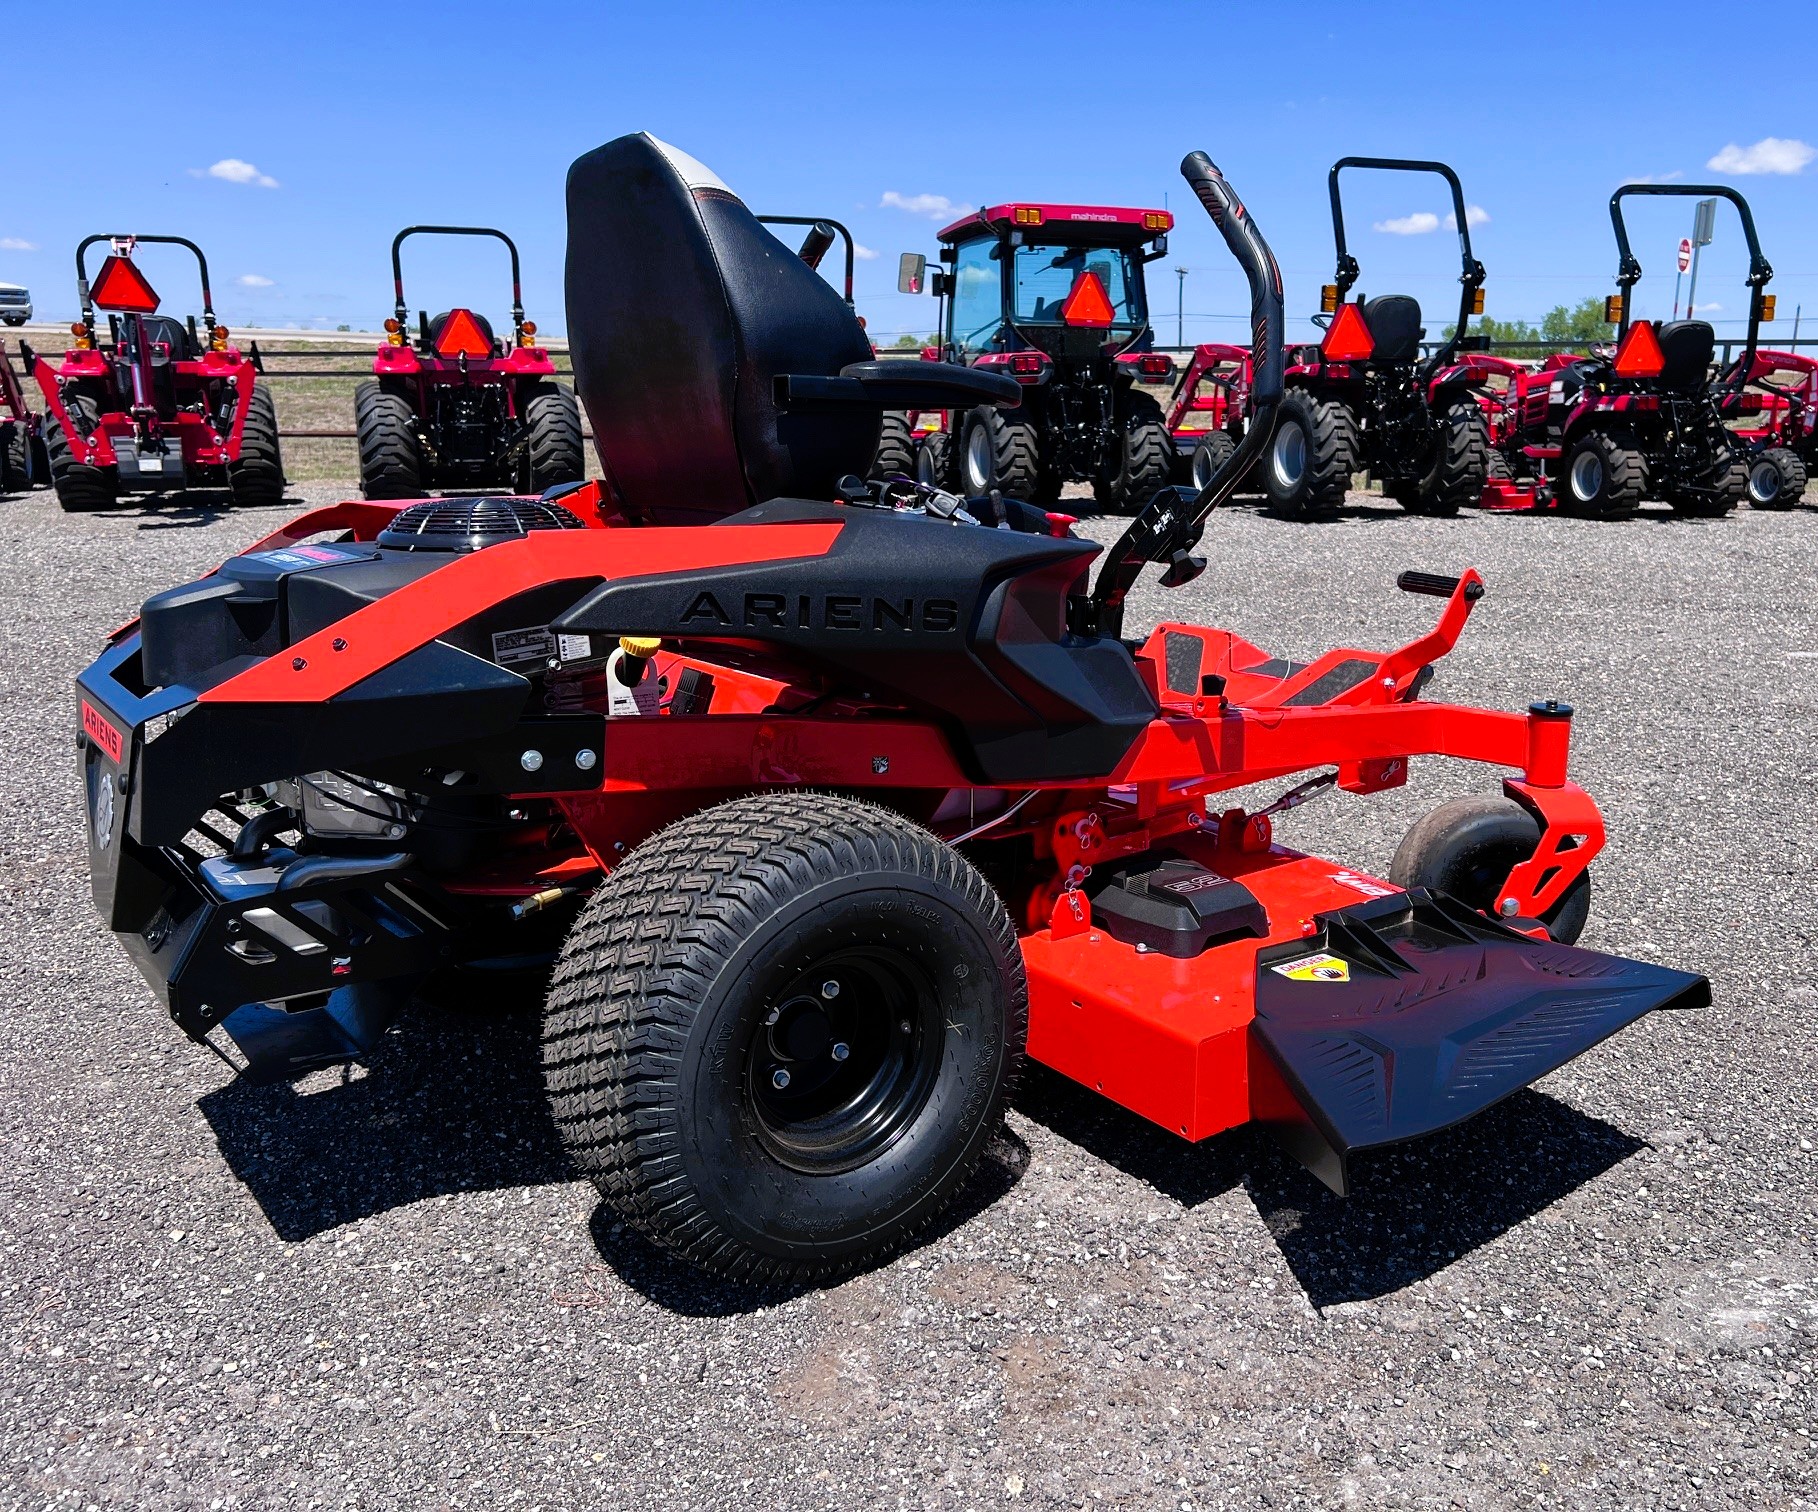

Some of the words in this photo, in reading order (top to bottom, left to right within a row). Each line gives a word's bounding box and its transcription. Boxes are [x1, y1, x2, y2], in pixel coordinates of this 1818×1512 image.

[1071, 212, 1117, 222] mahindra
[679, 591, 959, 633] ARIENS
[84, 707, 118, 755] ARIENS
[1280, 956, 1326, 971] DANGER
